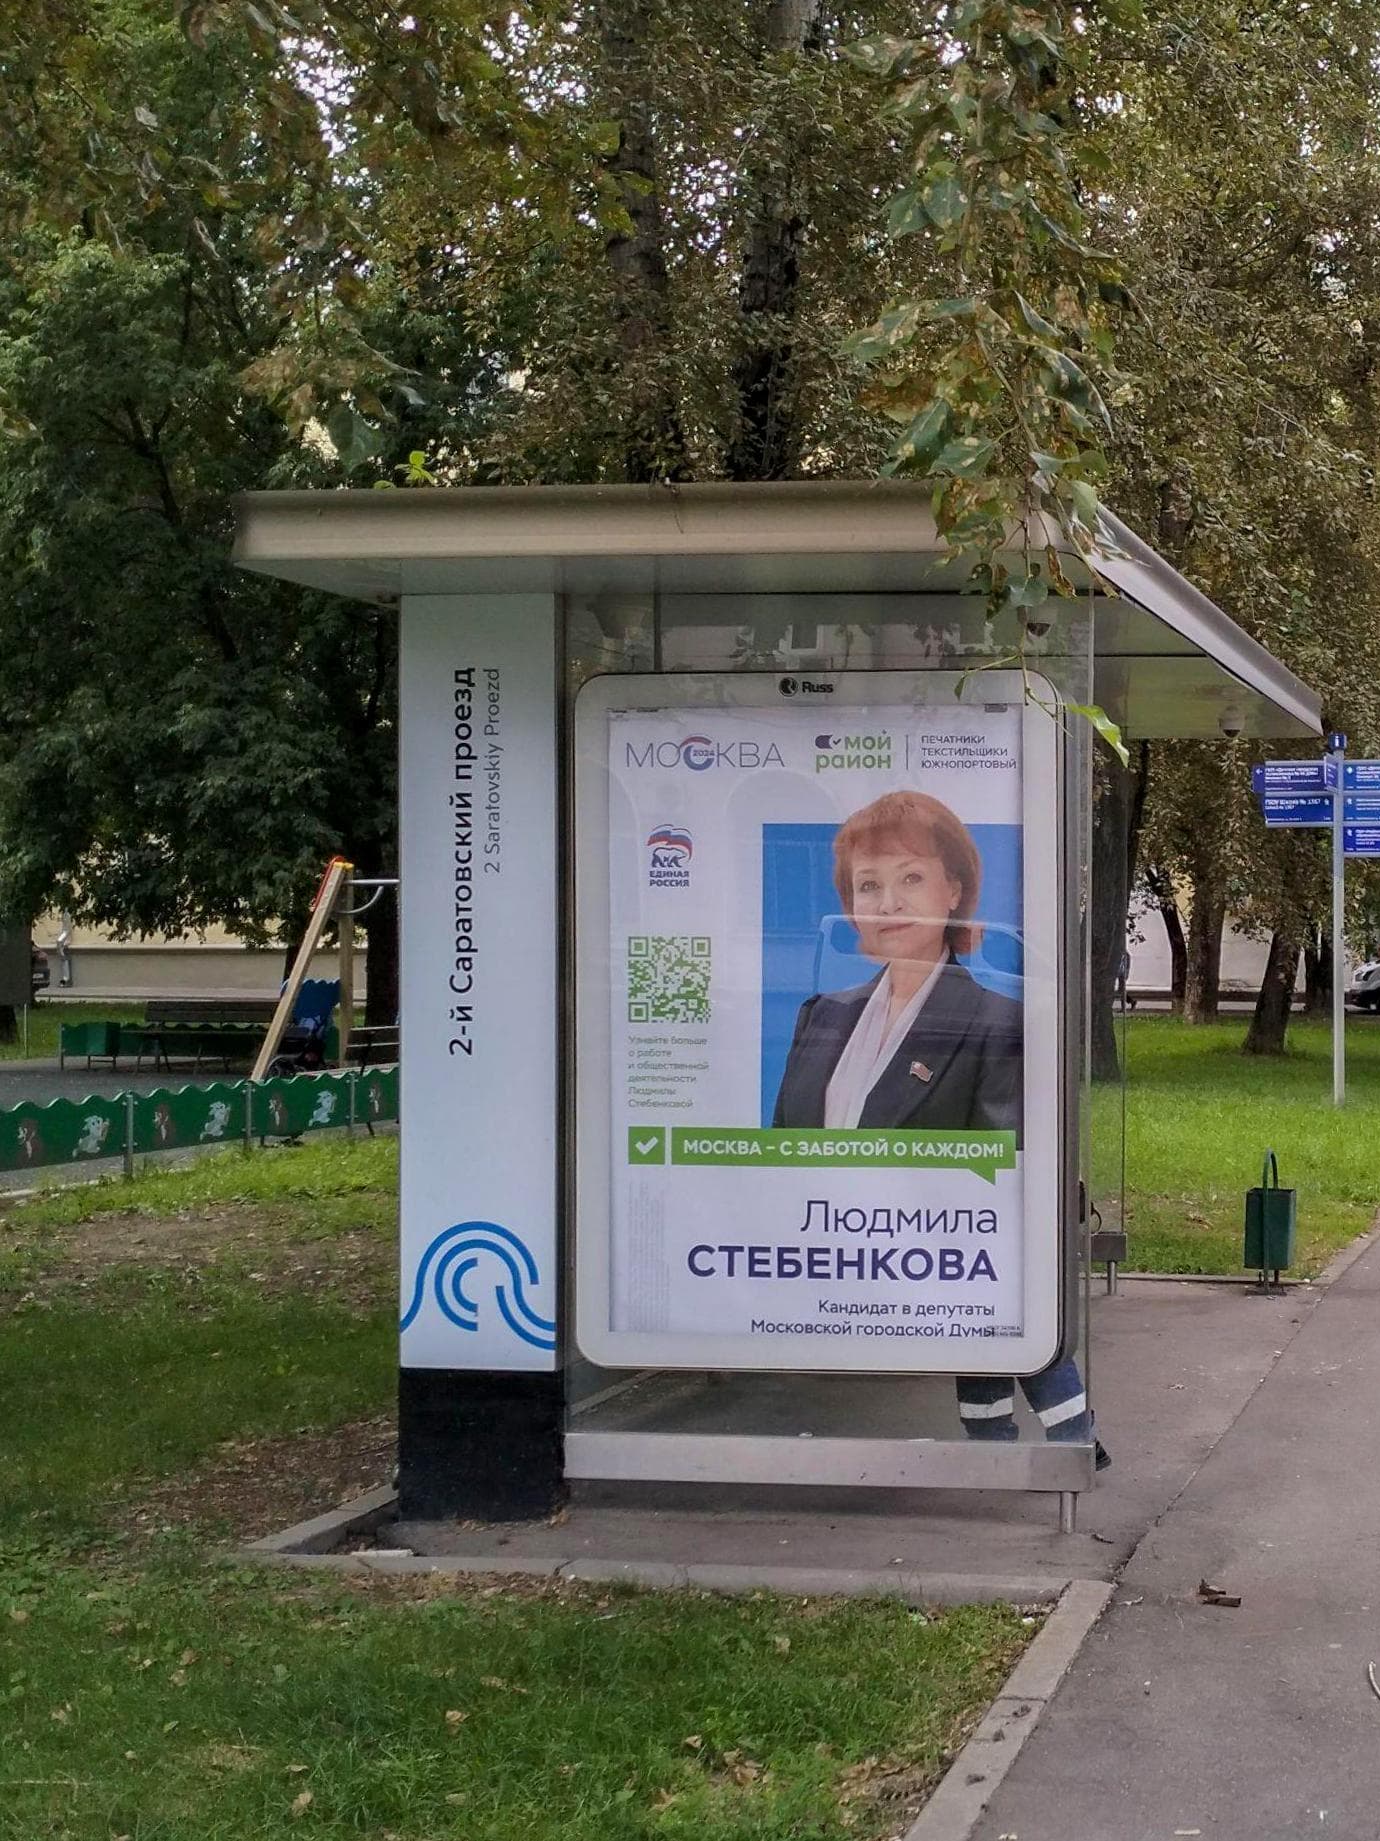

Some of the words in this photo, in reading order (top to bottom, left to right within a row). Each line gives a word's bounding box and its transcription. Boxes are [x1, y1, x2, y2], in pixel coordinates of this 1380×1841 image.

[801, 680, 834, 694] Russ
[483, 668, 501, 736] Proezd
[455, 667, 478, 780] проезд
[921, 735, 986, 744] ПЕЧАТНИКИ
[626, 735, 786, 771] МОСКВА
[921, 747, 1008, 757] ТЕКСТИЛЬЩИКИ
[921, 758, 1017, 769] ЮЖНОПОРТОВЫЙ
[484, 743, 505, 855] Saratovskiy
[484, 861, 501, 874] 2
[649, 870, 690, 878] ЕДИНАЯ
[449, 791, 478, 994] Саратовский
[649, 879, 690, 887] РОССИЯ
[449, 1005, 473, 1057] 2-й
[683, 1138, 762, 1155] МОСКВА
[779, 1140, 793, 1156] С
[799, 1138, 889, 1158] ЗАБОТОЙ
[893, 1142, 907, 1158] О
[911, 1142, 1005, 1160] КАЖДОМ!
[800, 1199, 998, 1238] Людмила
[686, 1243, 999, 1282] СТЕБЕНКОВА
[818, 1299, 898, 1316] Кандидат
[902, 1304, 912, 1315] в
[915, 1304, 995, 1319] депутаты
[751, 1319, 852, 1335] Московской
[856, 1321, 945, 1337] городской
[949, 1323, 995, 1338] Думы
